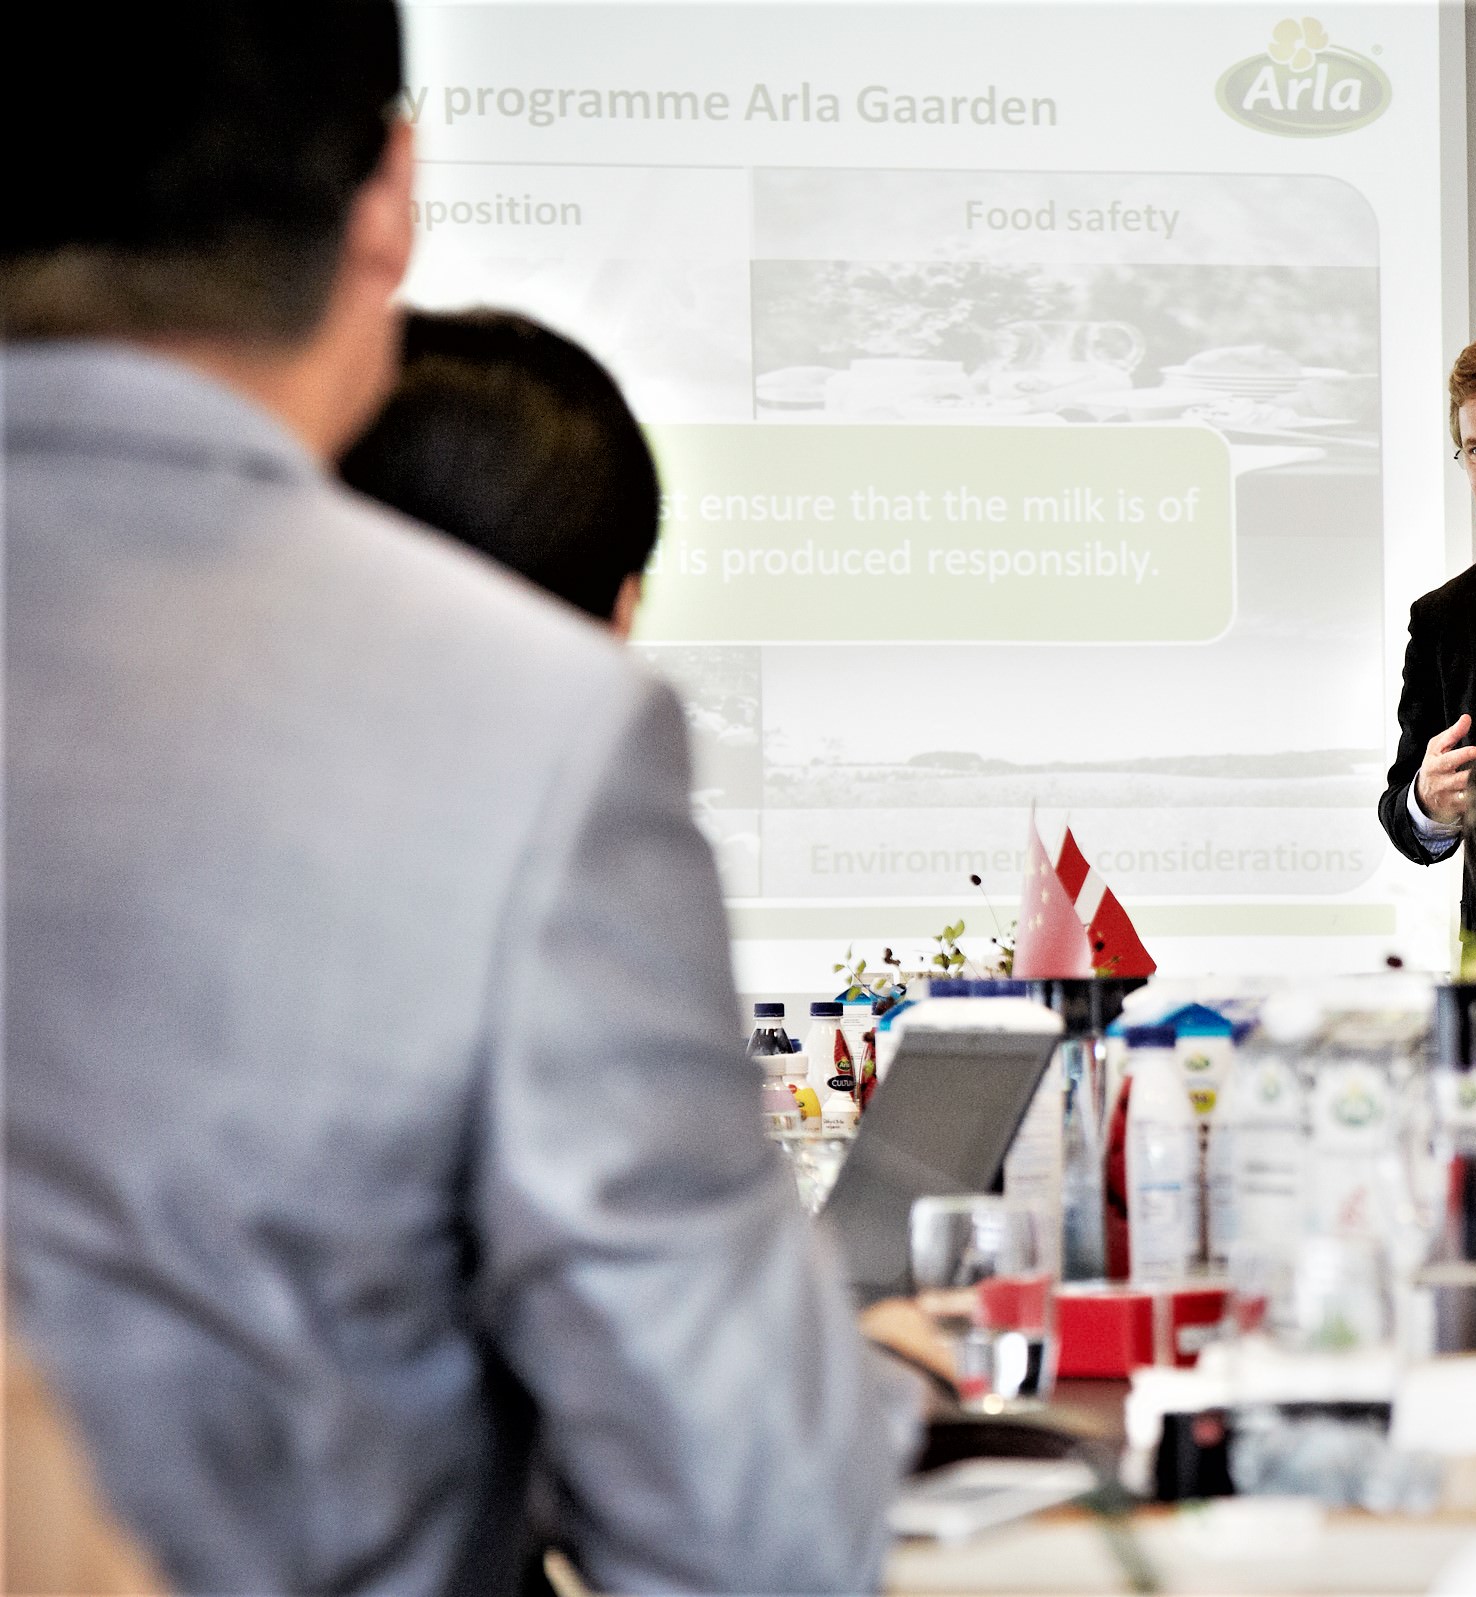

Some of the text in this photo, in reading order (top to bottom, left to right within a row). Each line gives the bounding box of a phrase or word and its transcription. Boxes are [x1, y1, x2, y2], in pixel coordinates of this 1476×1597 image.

[443, 84, 730, 128] programme
[744, 82, 841, 123] Arla
[856, 84, 1058, 127] Gaarden
[1241, 62, 1363, 112] Arla
[964, 199, 1181, 240] Food safety
[699, 493, 836, 522] ensure
[850, 485, 932, 522] that
[943, 485, 1008, 523] the
[1022, 486, 1106, 523] milk
[1117, 487, 1146, 523] is
[1156, 486, 1201, 523] of
[678, 539, 708, 576] is
[722, 539, 912, 584] produced
[927, 540, 1160, 585] responsibly.
[809, 840, 1364, 875] Environme considerations
